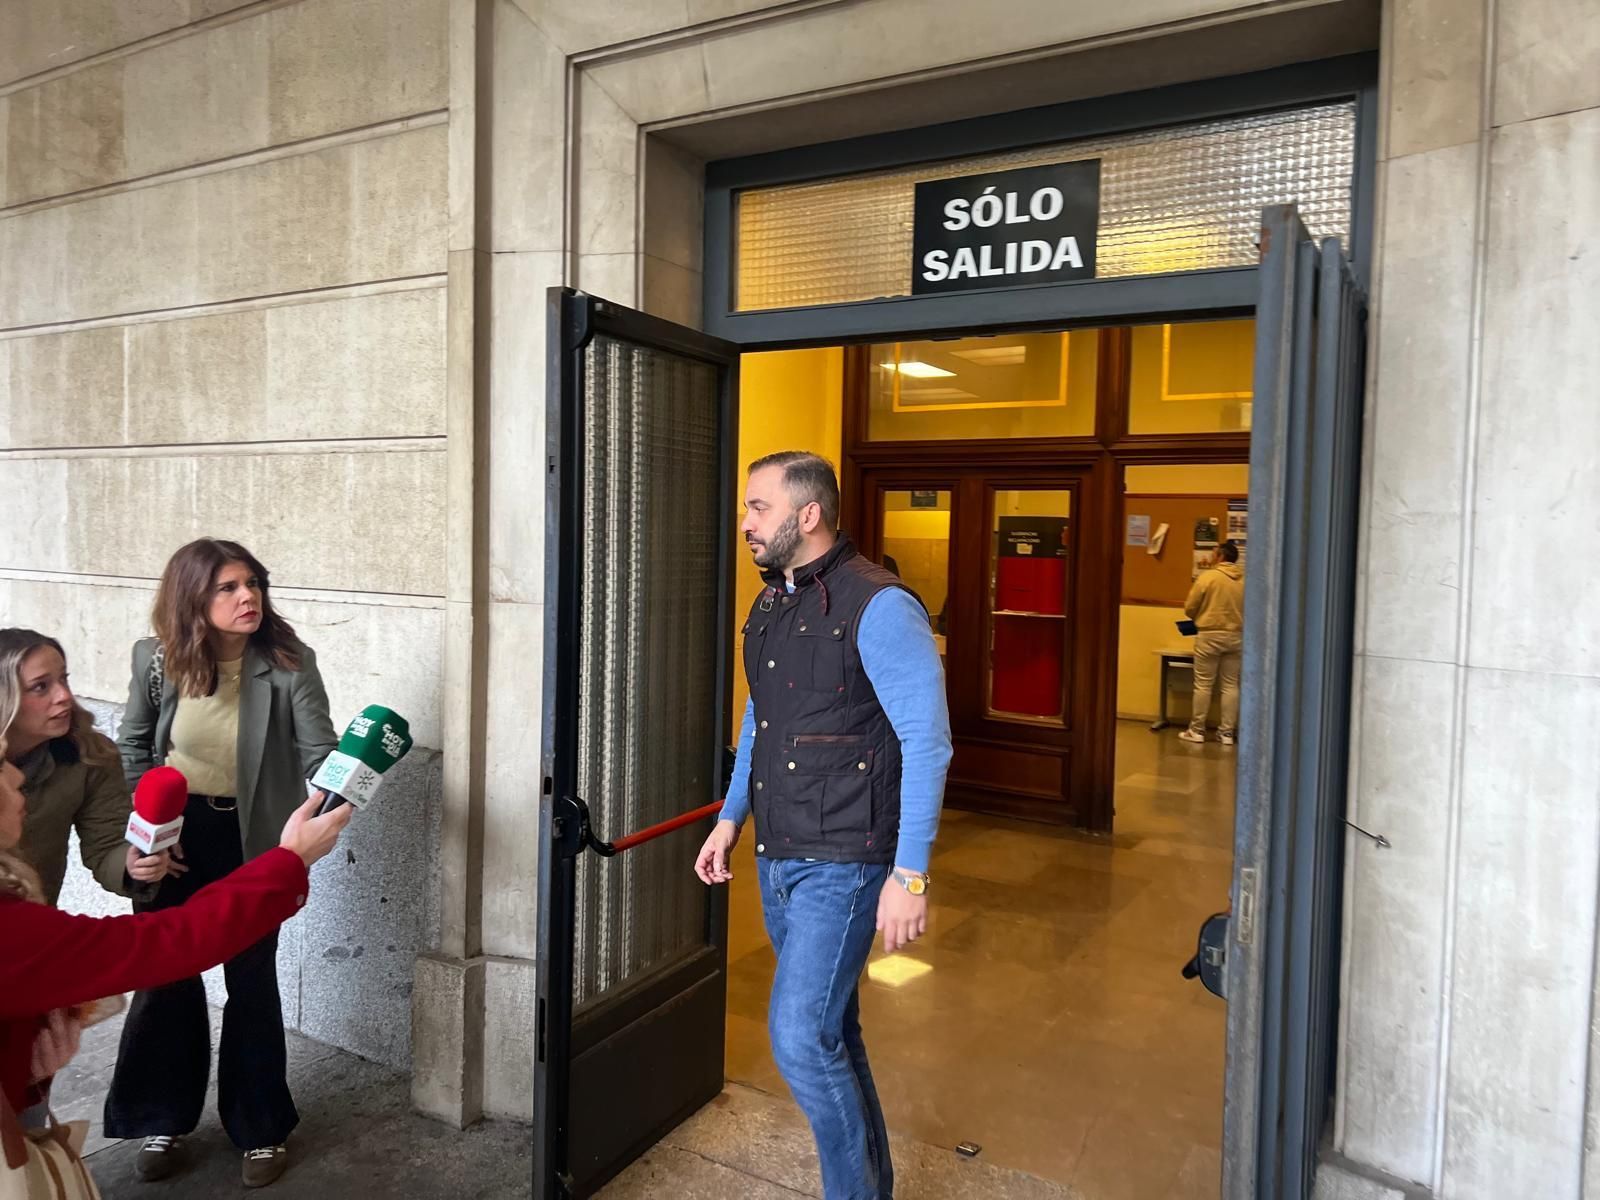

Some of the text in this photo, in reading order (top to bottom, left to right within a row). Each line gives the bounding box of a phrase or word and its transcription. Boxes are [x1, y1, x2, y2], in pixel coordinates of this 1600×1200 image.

[943, 186, 1064, 231] SÓLO
[922, 236, 1084, 282] SALIDA
[384, 731, 405, 747] HOY
[327, 763, 351, 776] HOY
